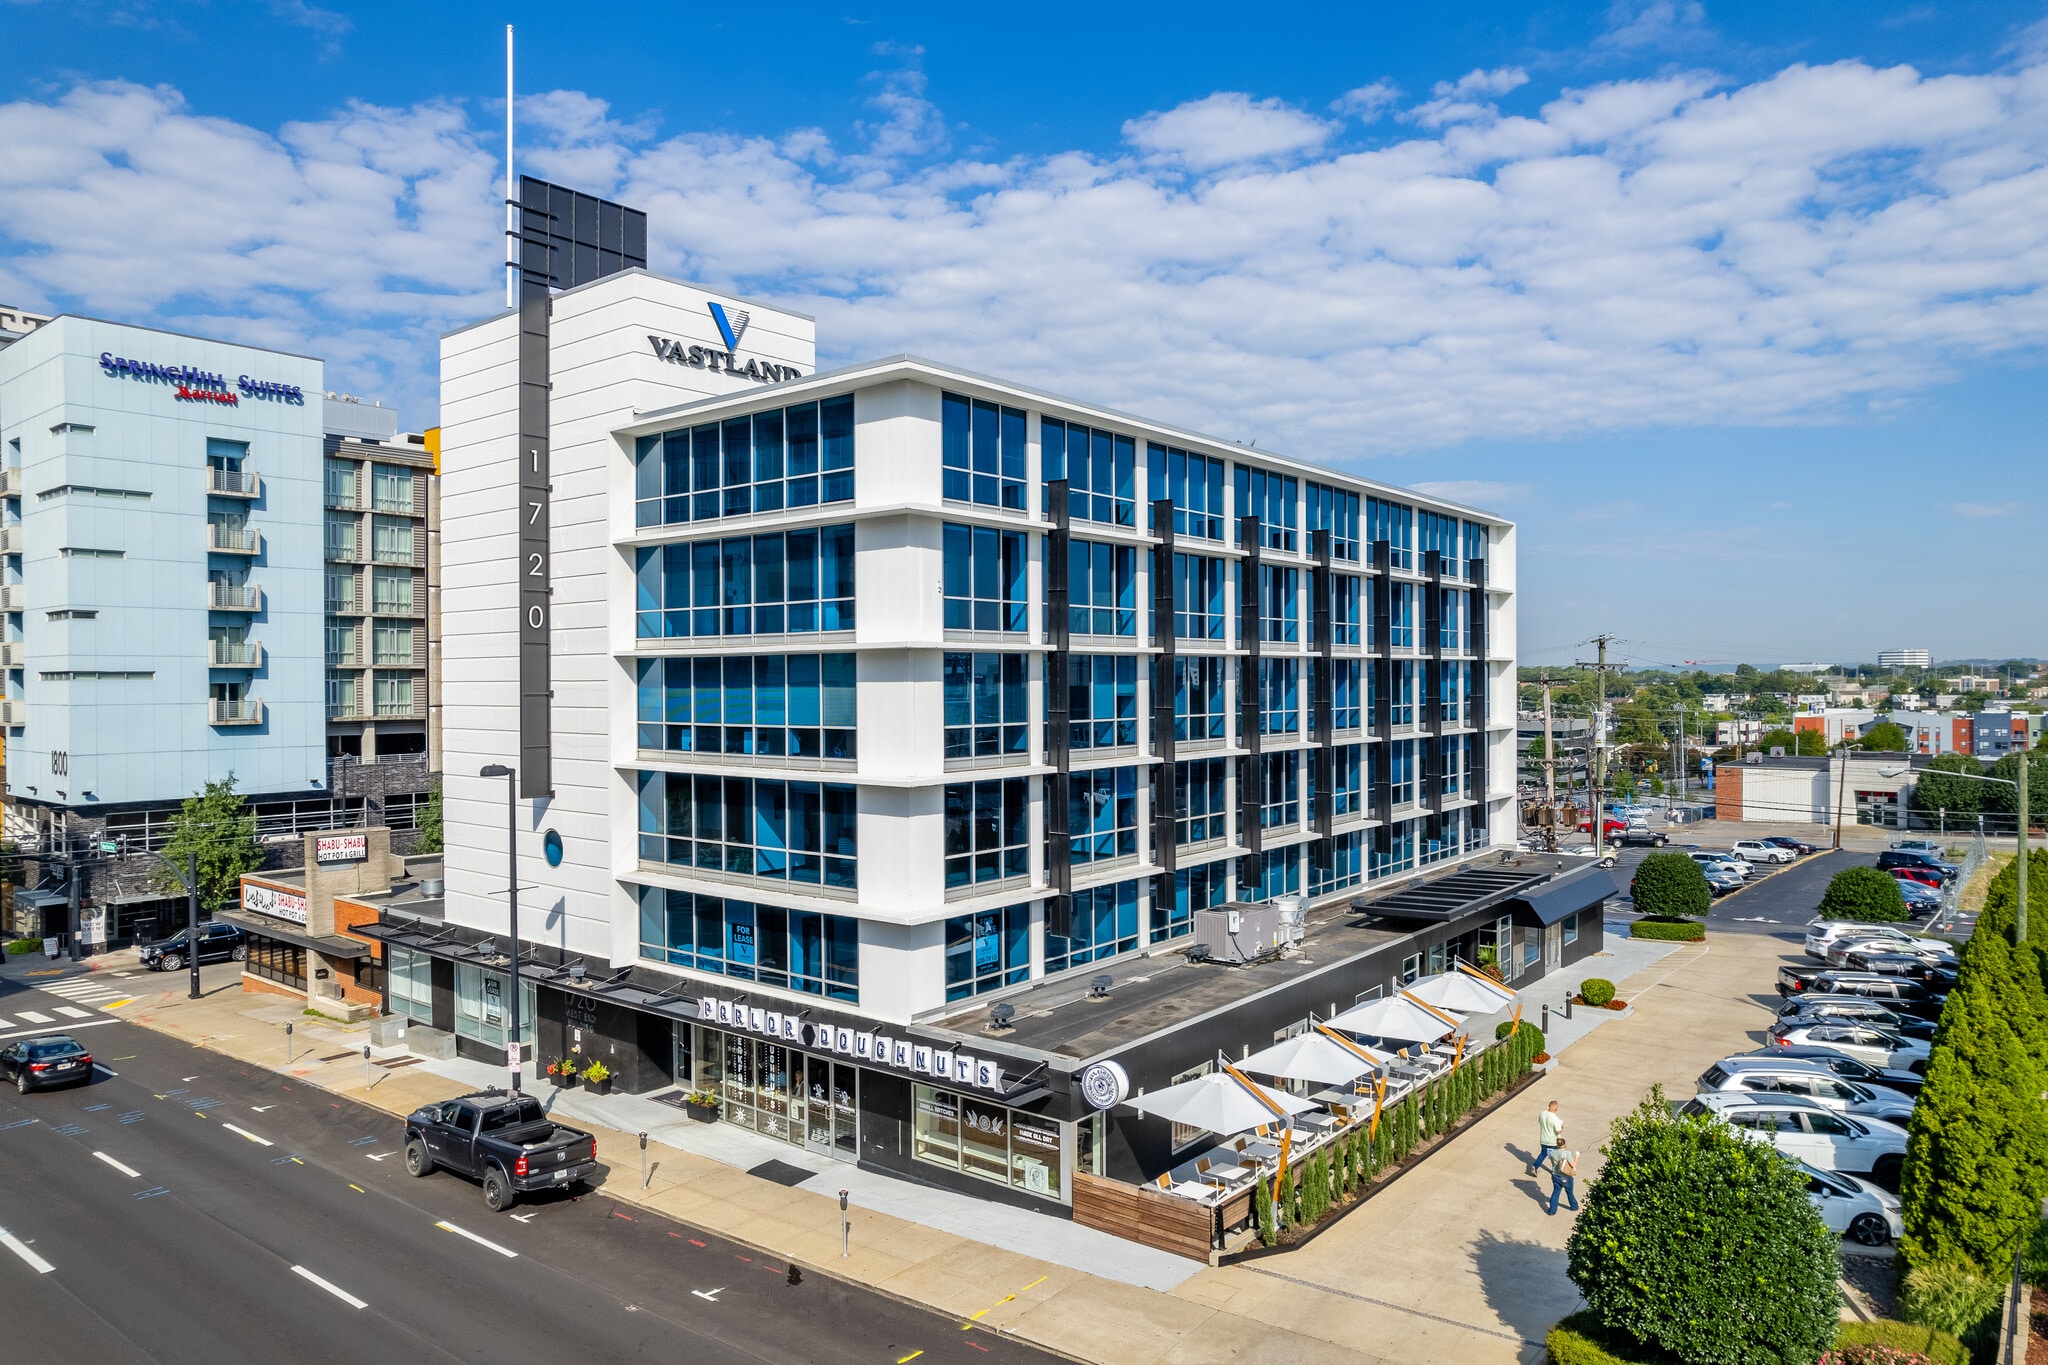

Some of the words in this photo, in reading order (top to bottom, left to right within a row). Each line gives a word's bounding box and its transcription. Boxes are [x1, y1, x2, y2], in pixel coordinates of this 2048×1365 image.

[647, 334, 802, 383] VASTLAND
[174, 385, 237, 404] Marriott
[528, 449, 544, 629] 1720
[51, 750, 68, 777] 1800
[317, 838, 366, 852] SHABU-SHABU
[318, 852, 331, 861] HOT
[332, 851, 344, 860] POT
[349, 850, 366, 858] GRILL
[279, 908, 288, 918] HOT
[289, 911, 298, 919] POT
[736, 925, 751, 935] FOR
[734, 934, 754, 944] LEASE
[566, 1008, 582, 1020] WEST
[704, 1001, 795, 1038] PARLOR
[820, 1028, 990, 1084] DOUGHNUTS
